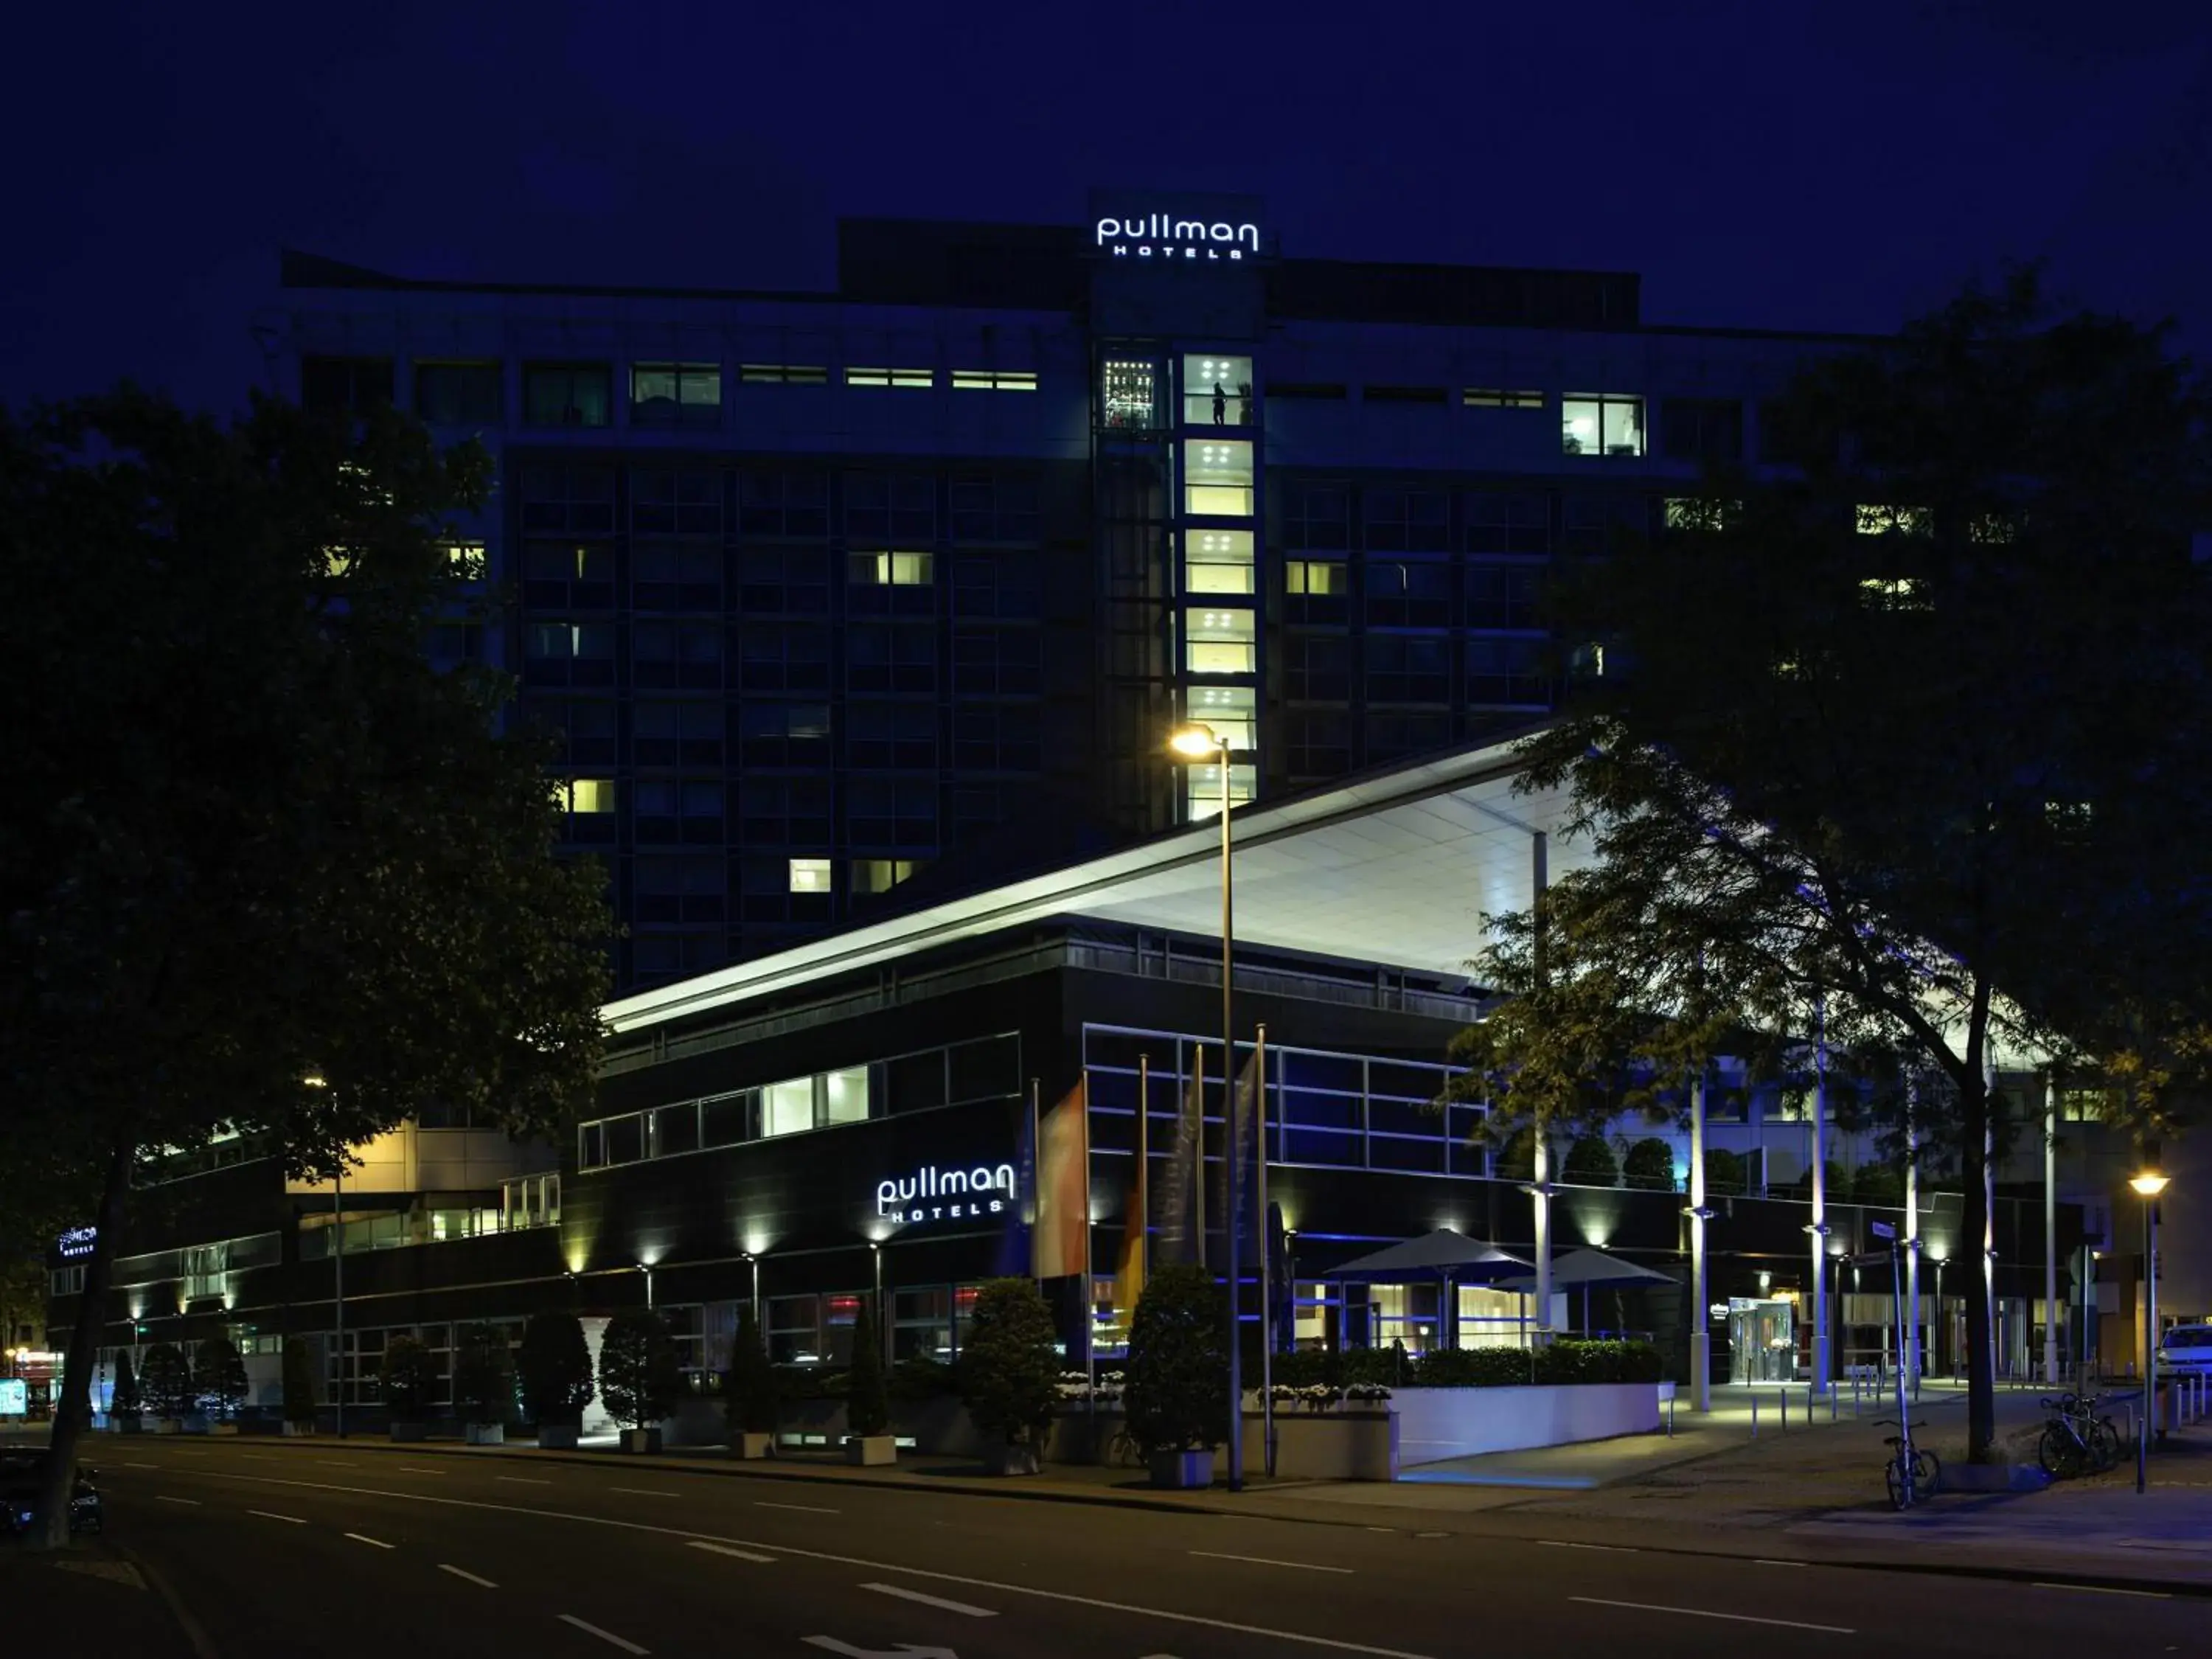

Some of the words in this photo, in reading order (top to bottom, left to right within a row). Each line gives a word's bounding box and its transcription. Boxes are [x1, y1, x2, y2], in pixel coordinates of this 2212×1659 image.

[1097, 213, 1259, 251] pullman
[1113, 245, 1242, 260] HOTELS
[877, 1164, 1015, 1217] pullman
[891, 1200, 1004, 1223] HOTELS
